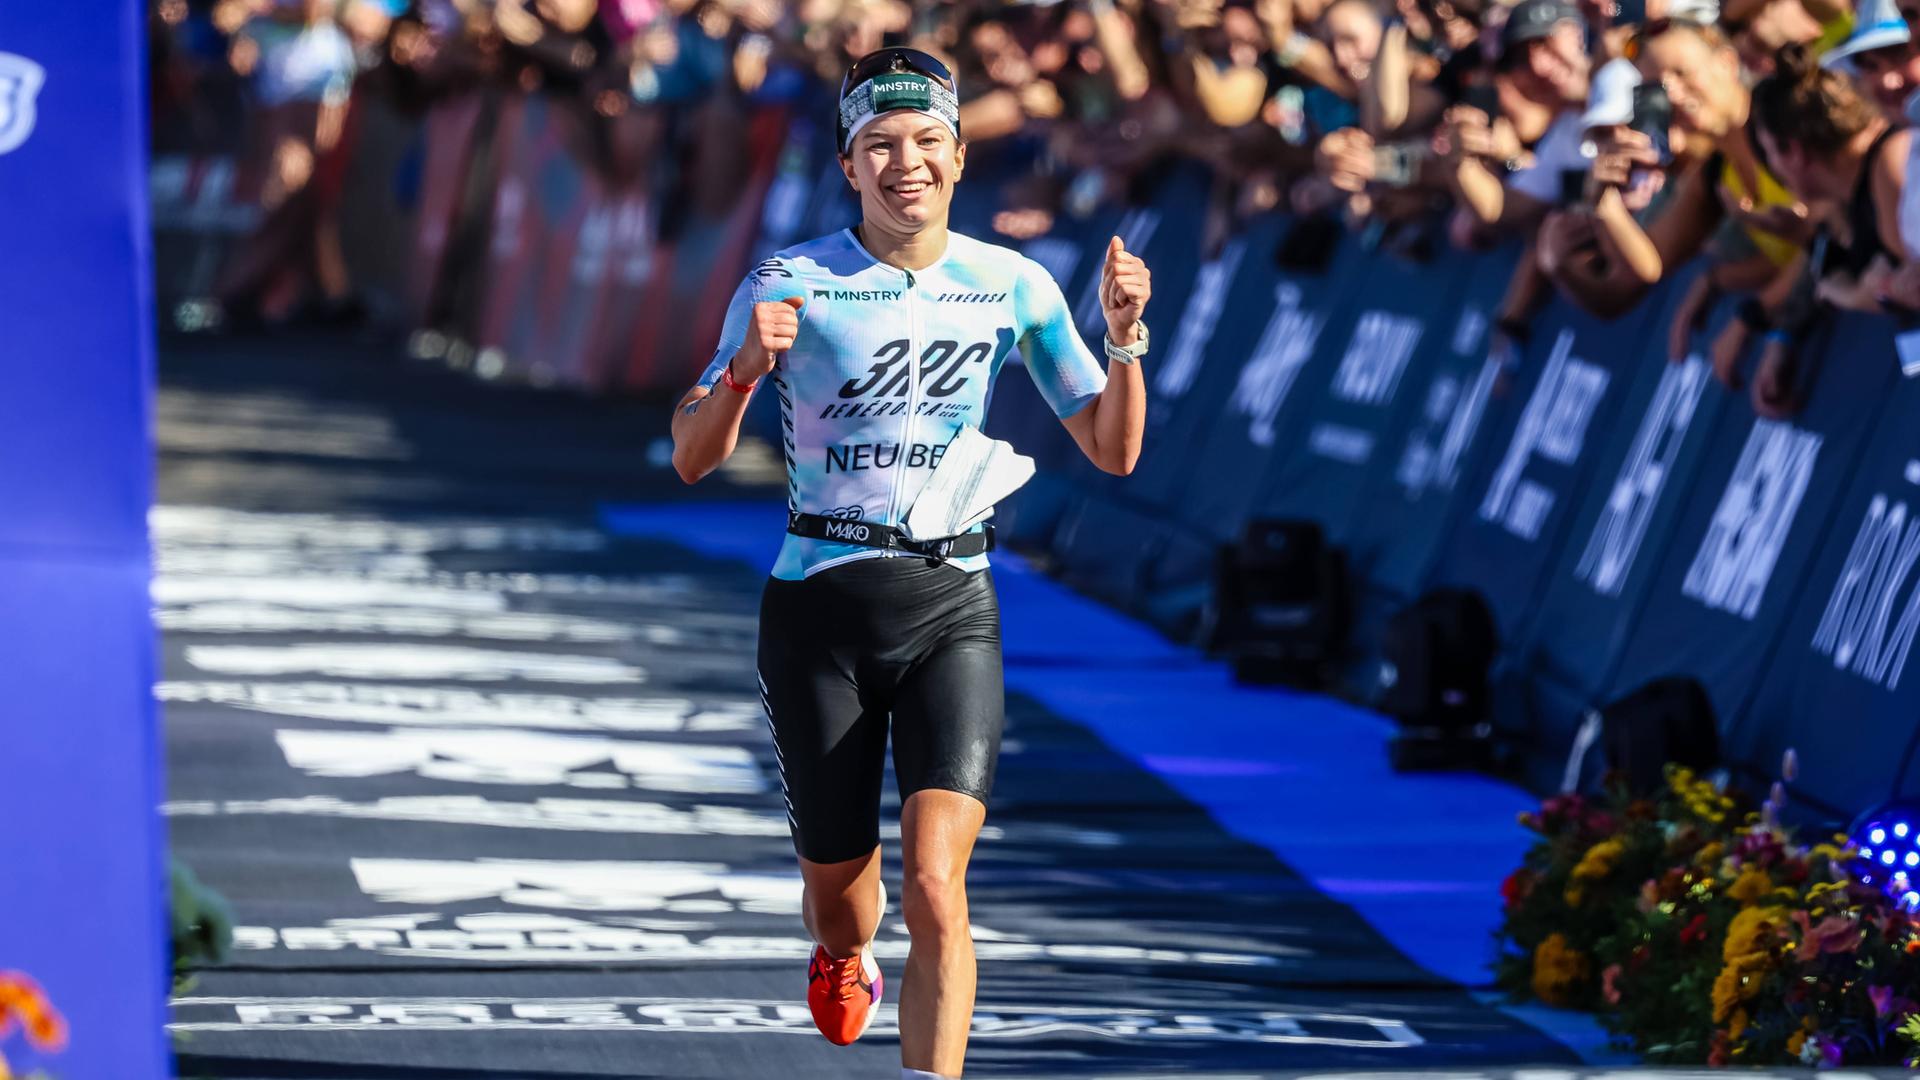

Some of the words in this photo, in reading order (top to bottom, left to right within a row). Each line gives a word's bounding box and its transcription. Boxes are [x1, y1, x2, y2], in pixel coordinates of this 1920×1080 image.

[874, 81, 927, 93] MNSTRY
[834, 290, 902, 301] MNSTRY
[826, 519, 870, 543] MAKO
